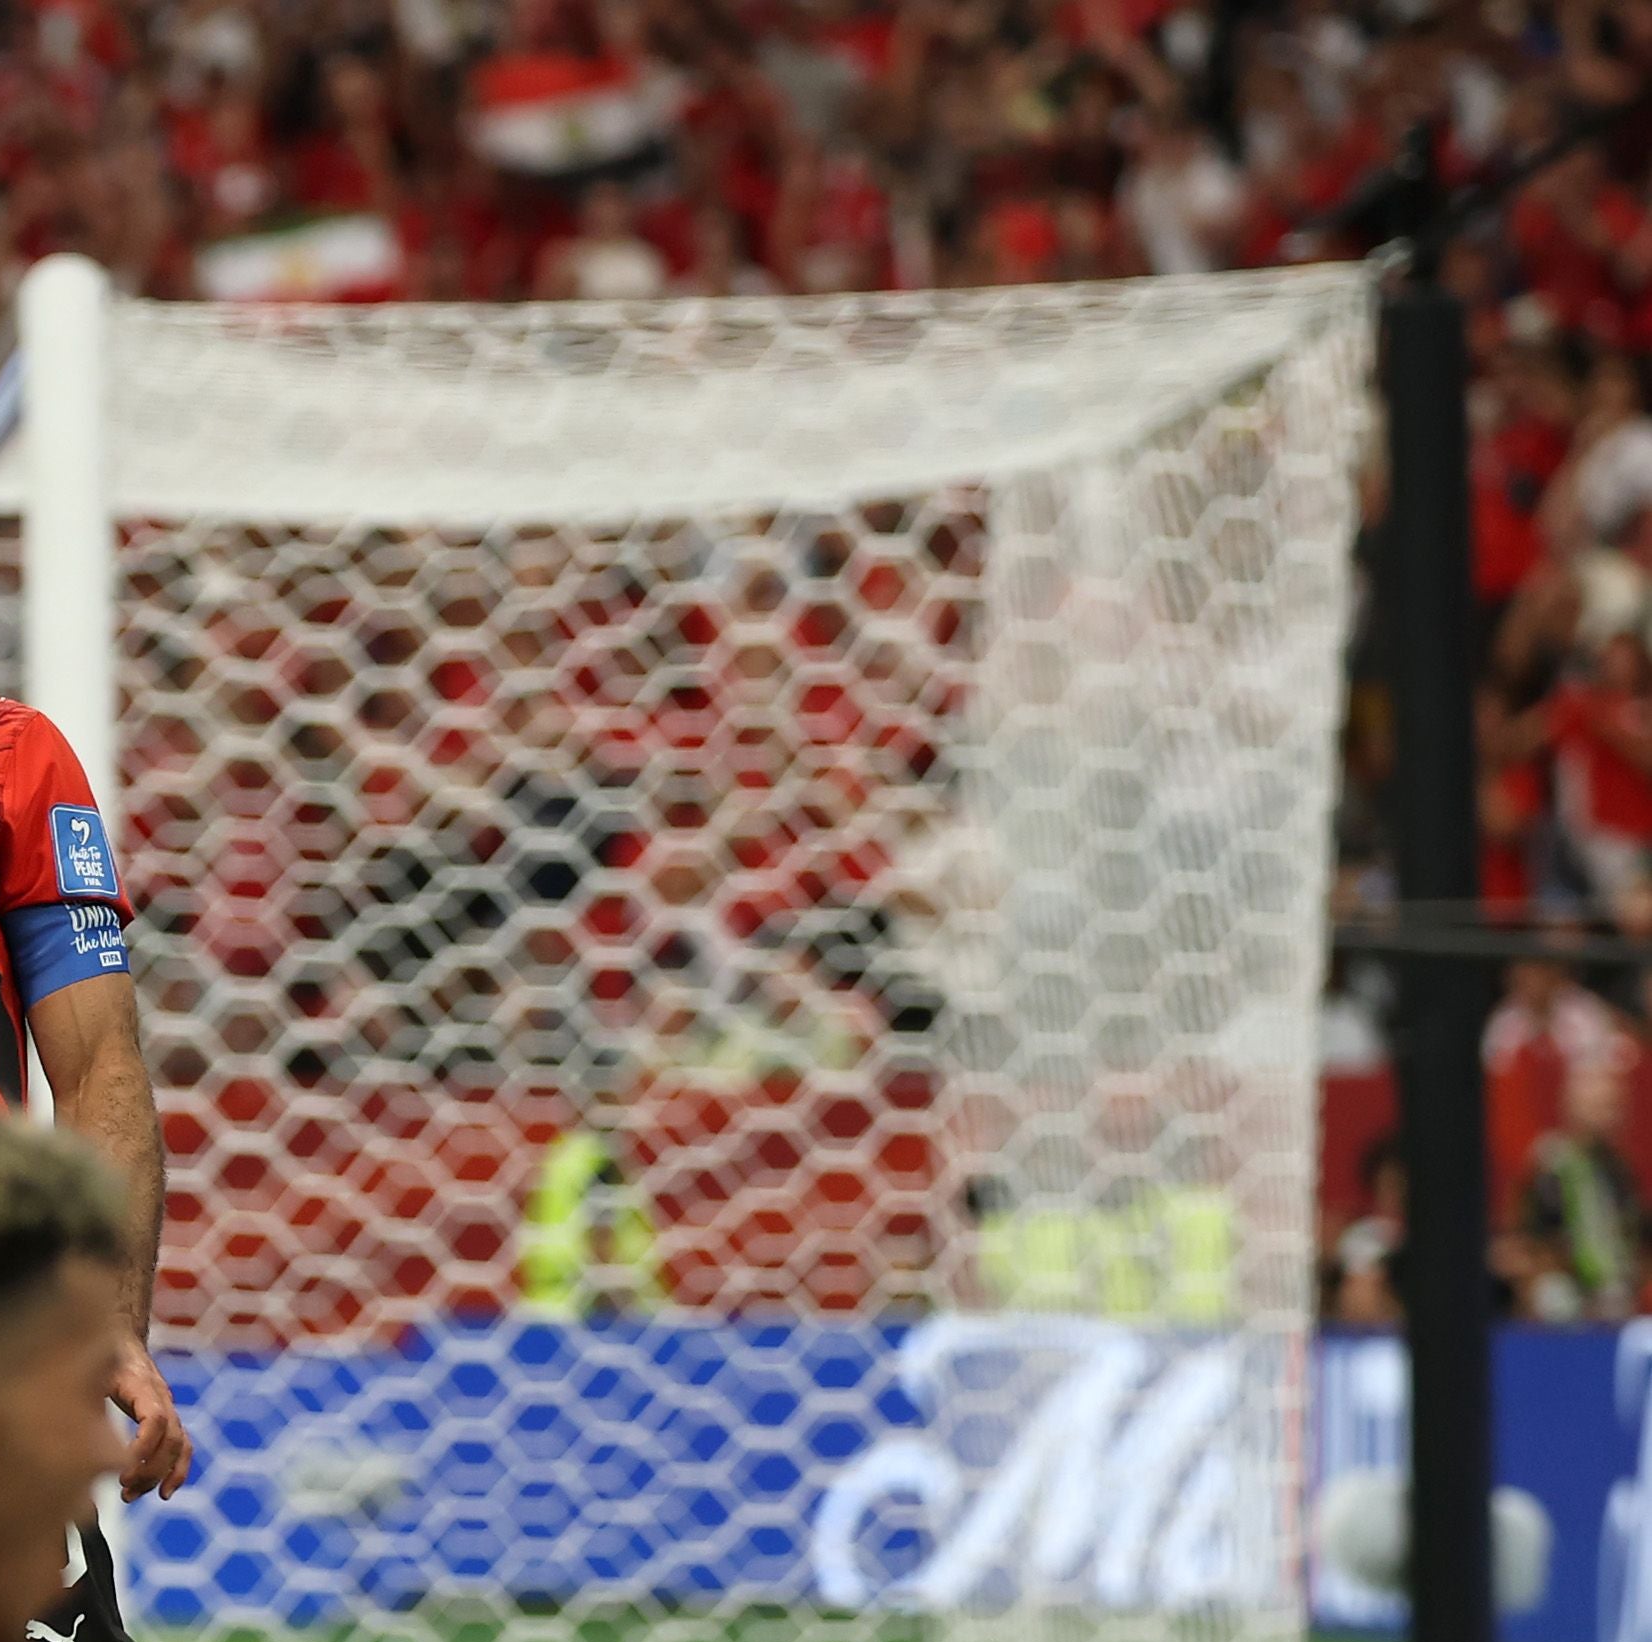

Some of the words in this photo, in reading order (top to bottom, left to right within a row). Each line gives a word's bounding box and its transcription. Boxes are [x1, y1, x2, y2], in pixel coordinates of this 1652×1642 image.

[73, 861, 105, 877] PEACE
[70, 932, 99, 954] the
[102, 953, 121, 964] FIFA
